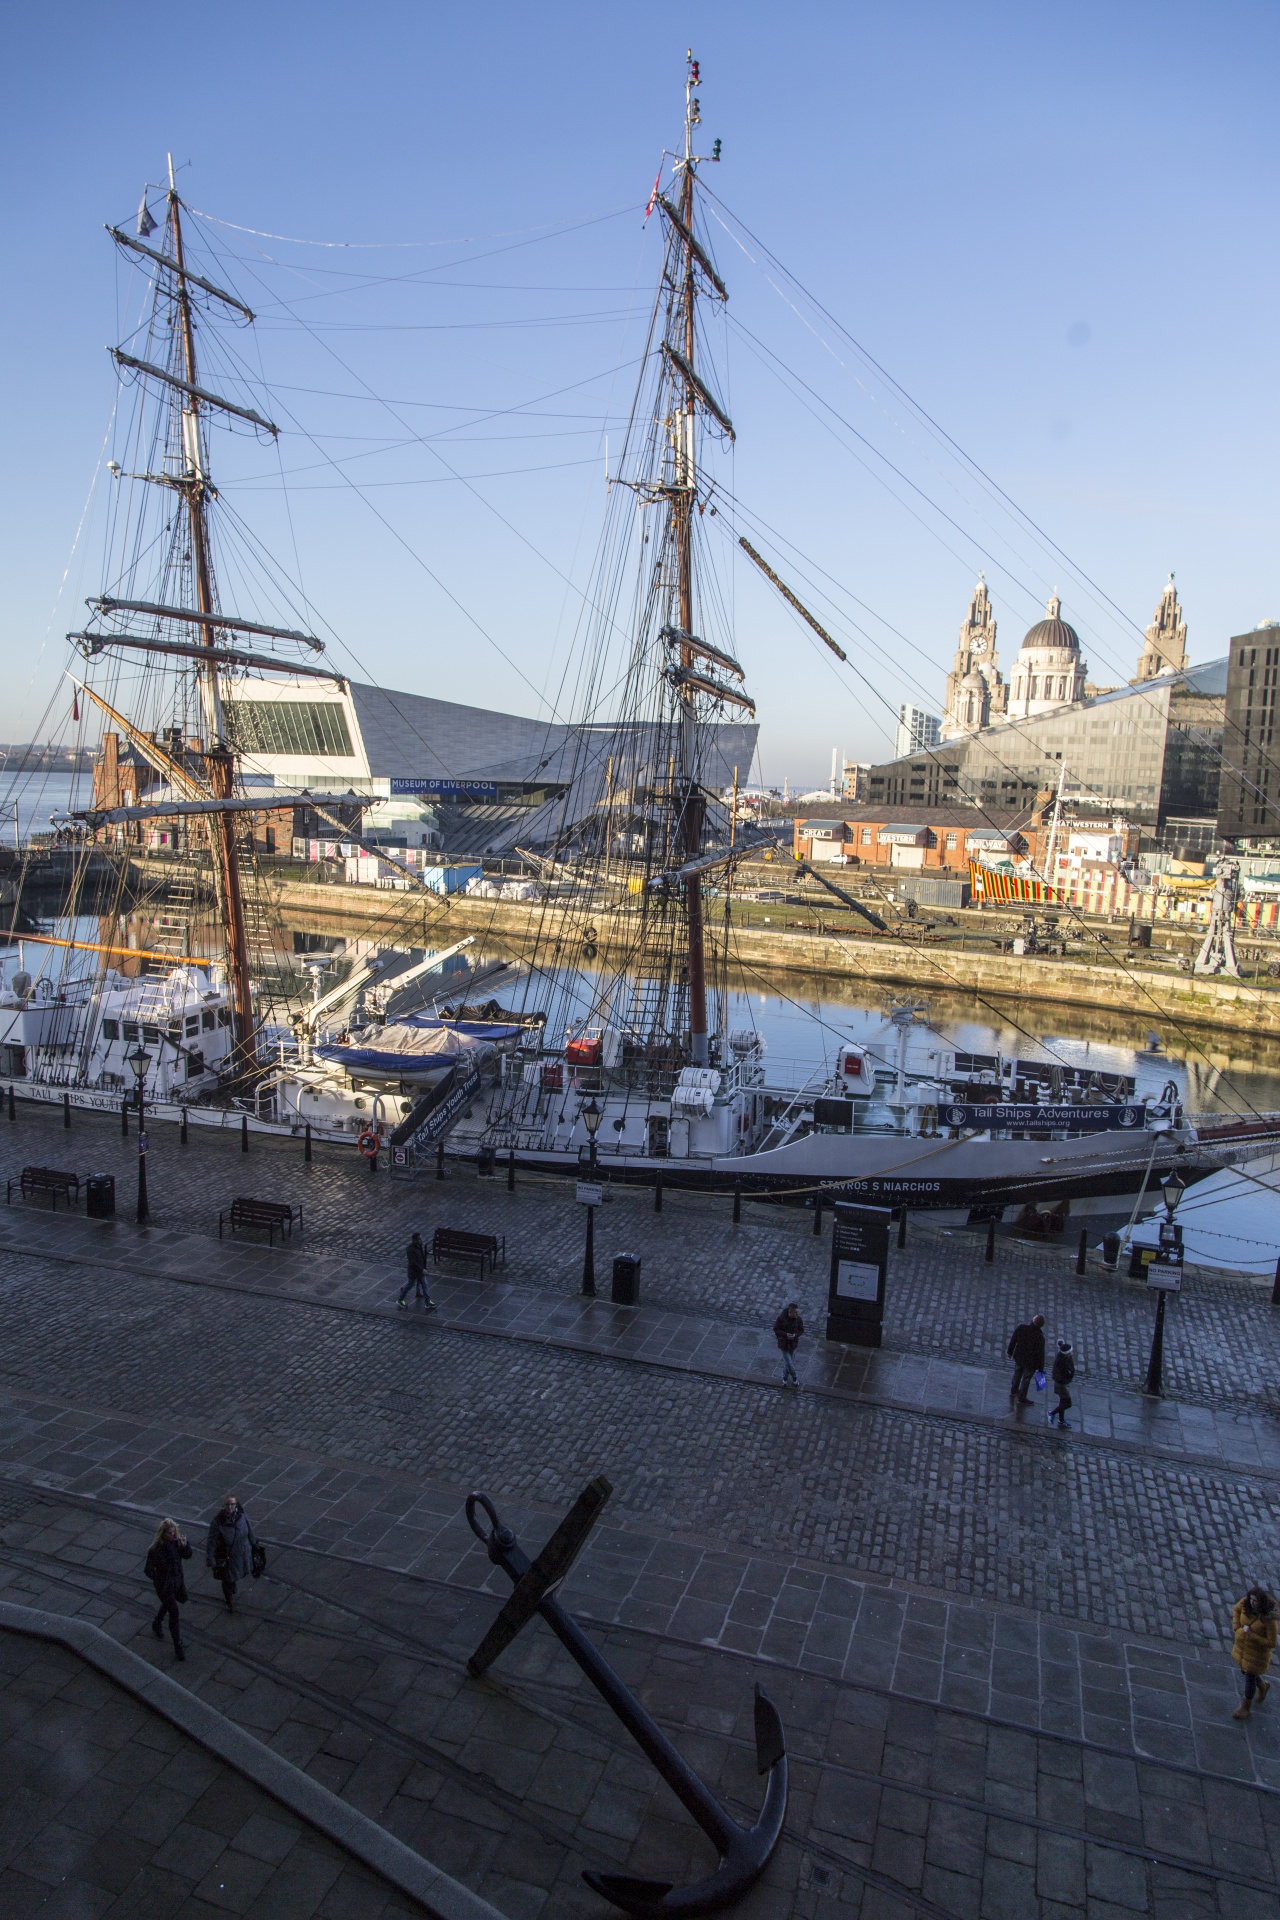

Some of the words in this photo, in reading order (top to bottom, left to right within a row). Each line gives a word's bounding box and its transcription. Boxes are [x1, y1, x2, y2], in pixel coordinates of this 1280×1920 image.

[392, 780, 427, 788] MUSEUM
[429, 780, 440, 788] OF
[442, 780, 495, 790] LIVERPOOL
[1072, 821, 1109, 829] WESTERN
[803, 829, 826, 837] GREAT
[879, 833, 915, 843] WESTERN
[30, 1087, 54, 1100] TALL
[417, 1126, 429, 1142] Tall
[429, 1108, 447, 1130] Ships
[446, 1088, 464, 1110] Youth
[463, 1072, 478, 1091] Trust
[972, 1107, 992, 1118] Tall
[996, 1107, 1031, 1120] Ships
[1037, 1107, 1109, 1119] Adventures
[1006, 1119, 1070, 1127] www.tallships.org
[872, 1182, 880, 1191] S
[883, 1182, 940, 1191] NIARCHOS
